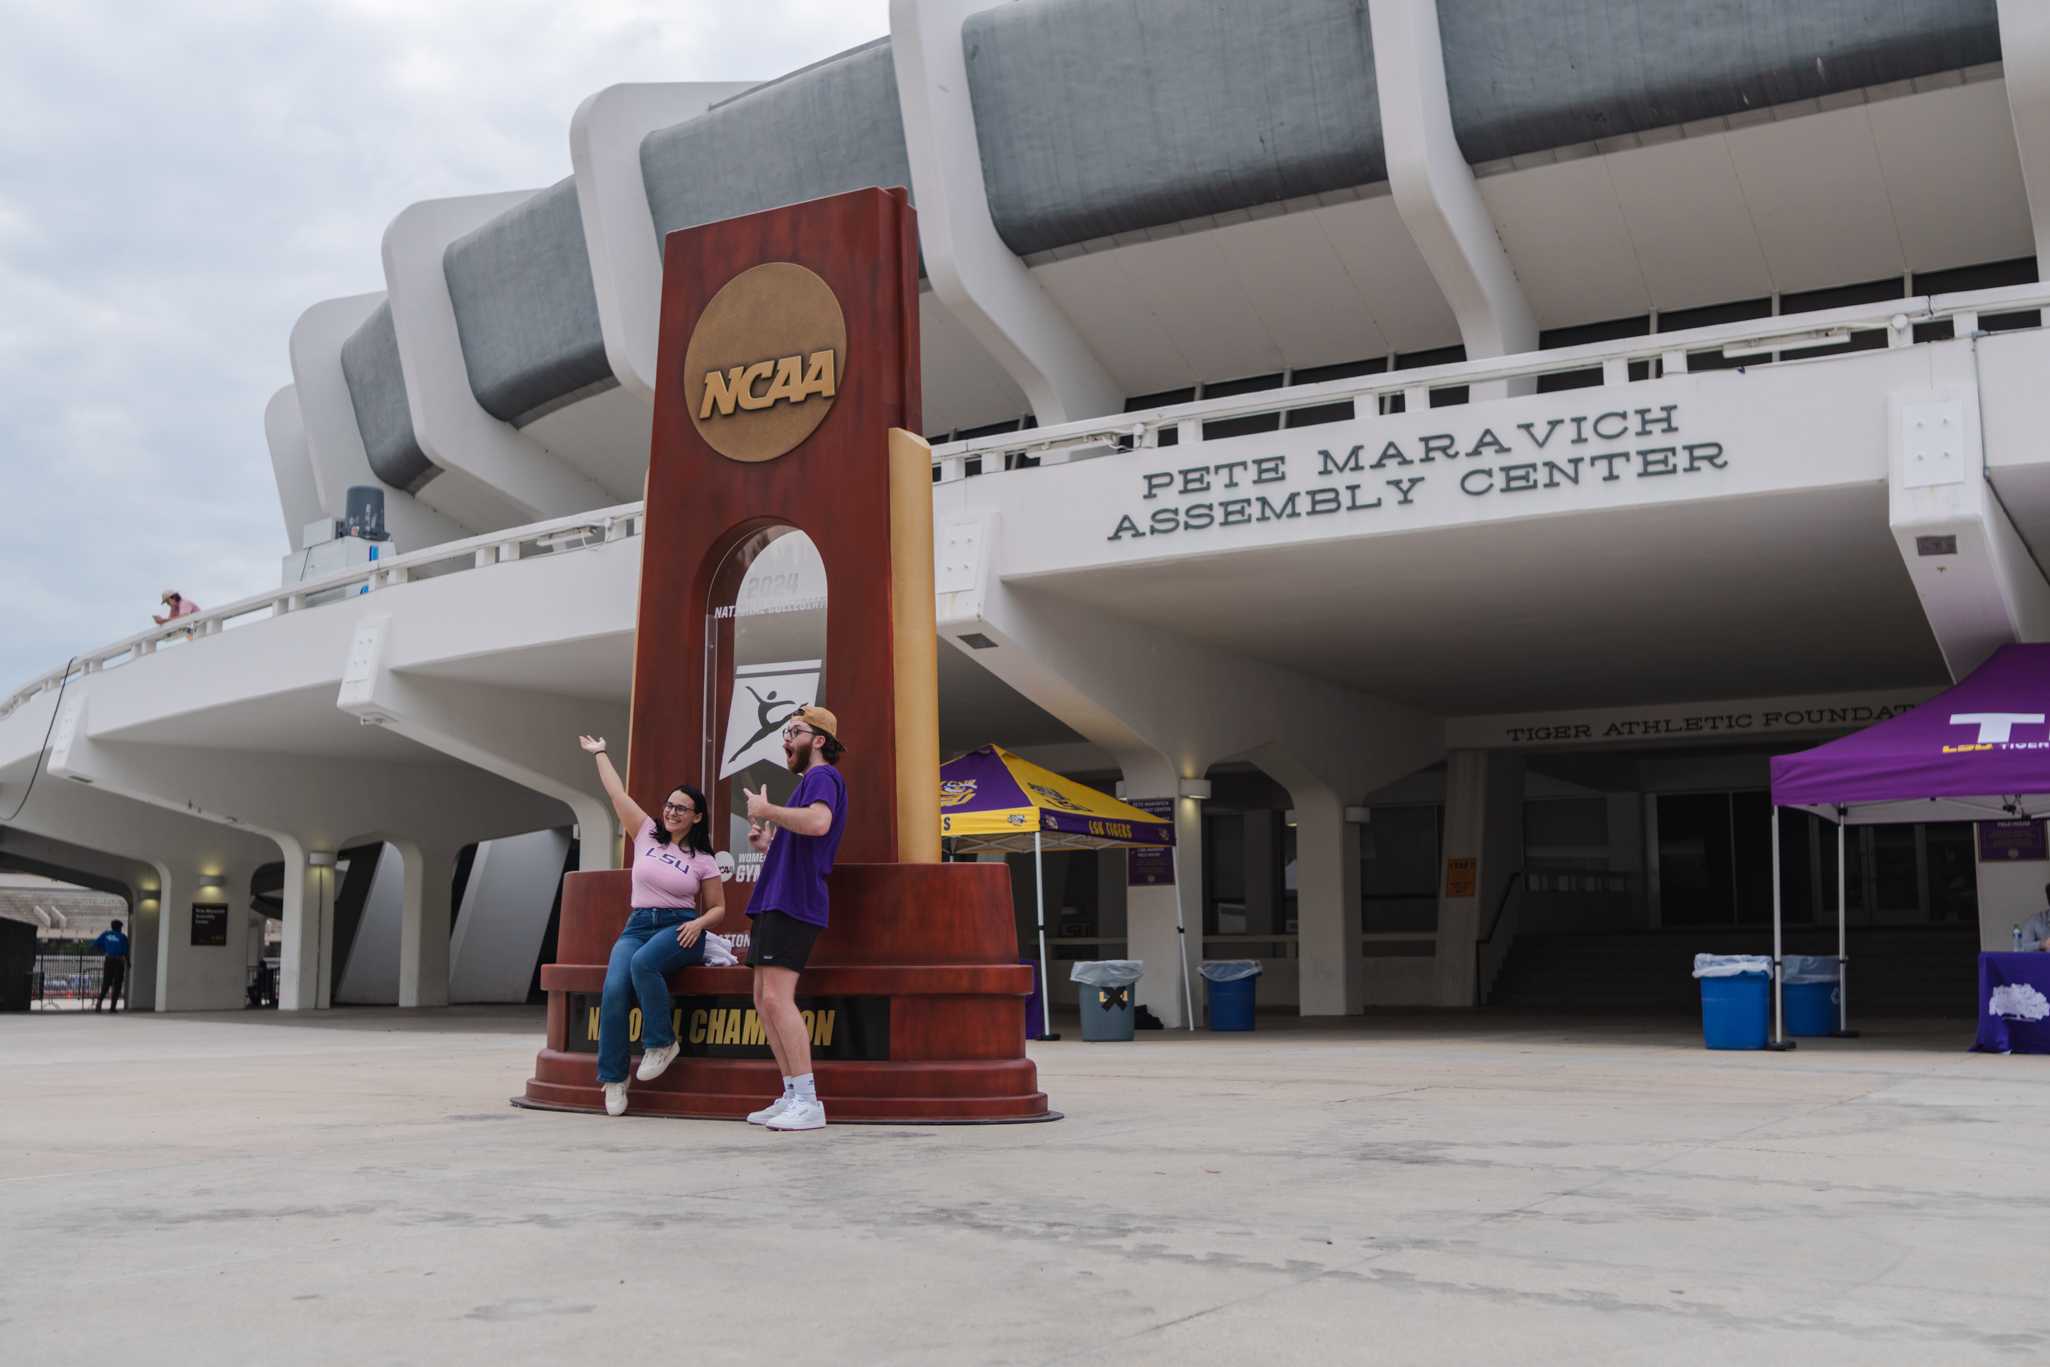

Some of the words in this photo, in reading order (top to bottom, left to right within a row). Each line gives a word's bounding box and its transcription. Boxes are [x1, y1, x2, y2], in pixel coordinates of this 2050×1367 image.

[700, 349, 836, 419] NCAA
[1142, 455, 1287, 498] PETE
[1318, 404, 1679, 476] MARAVICH
[1107, 477, 1425, 540] ASSEMBLY
[1460, 441, 1729, 495] CENTER
[1506, 724, 1593, 743] TIGER
[1602, 712, 1753, 738] ATHLETIC
[645, 848, 689, 874] LSU
